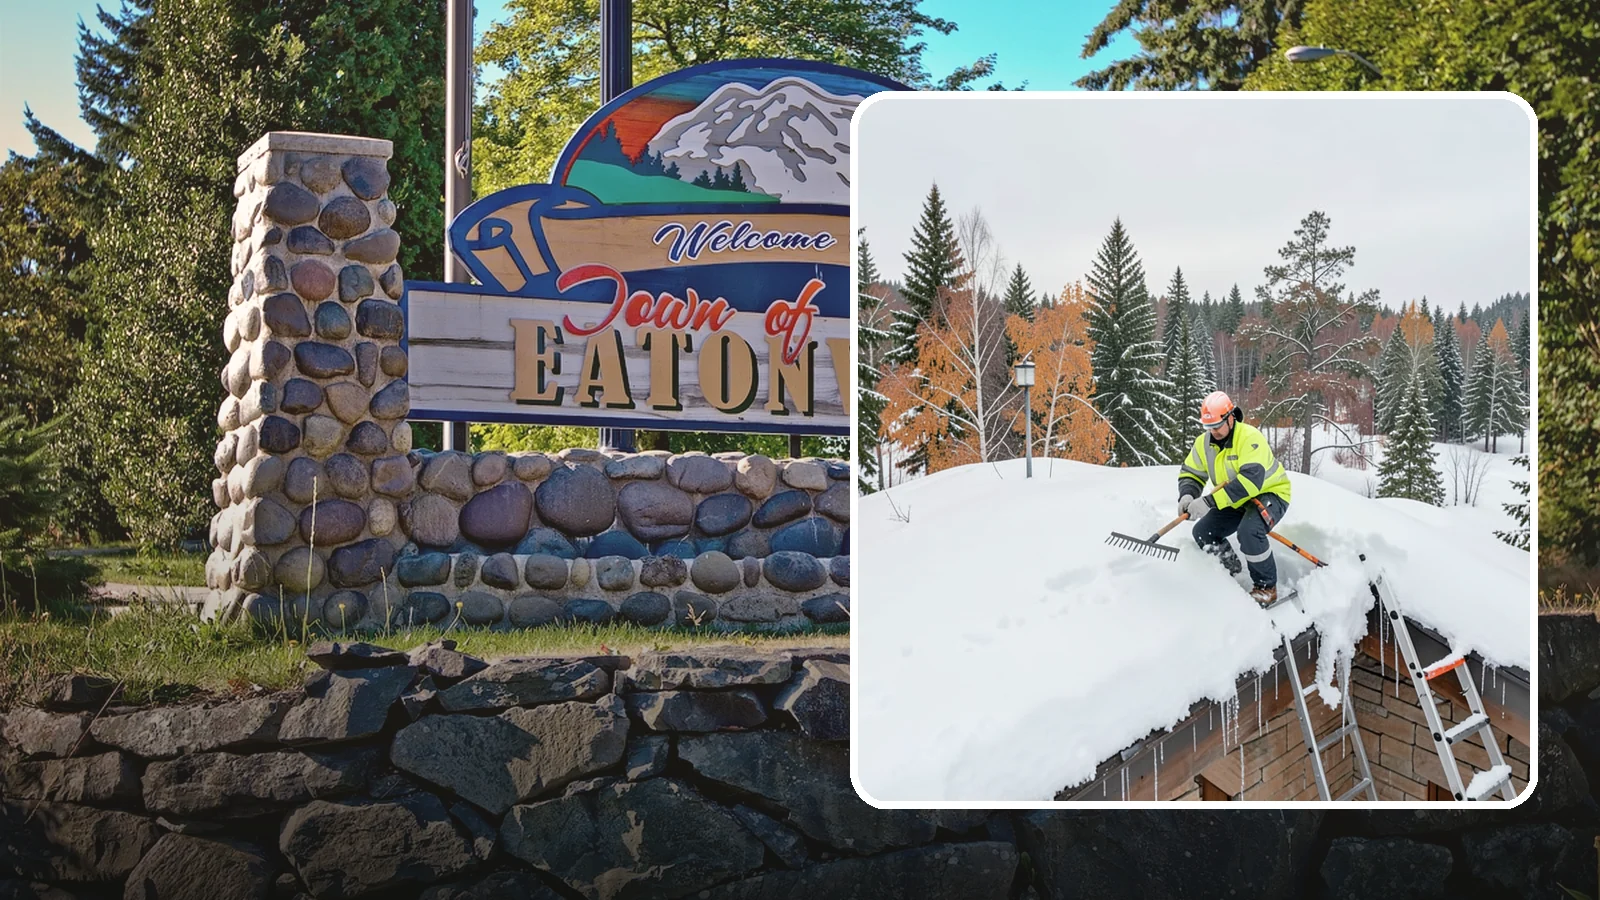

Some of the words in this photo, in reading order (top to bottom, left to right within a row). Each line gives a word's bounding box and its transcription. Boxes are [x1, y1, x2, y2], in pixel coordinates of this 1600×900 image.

[653, 220, 837, 263] Welcome
[556, 264, 735, 336] Town
[764, 278, 826, 365] of
